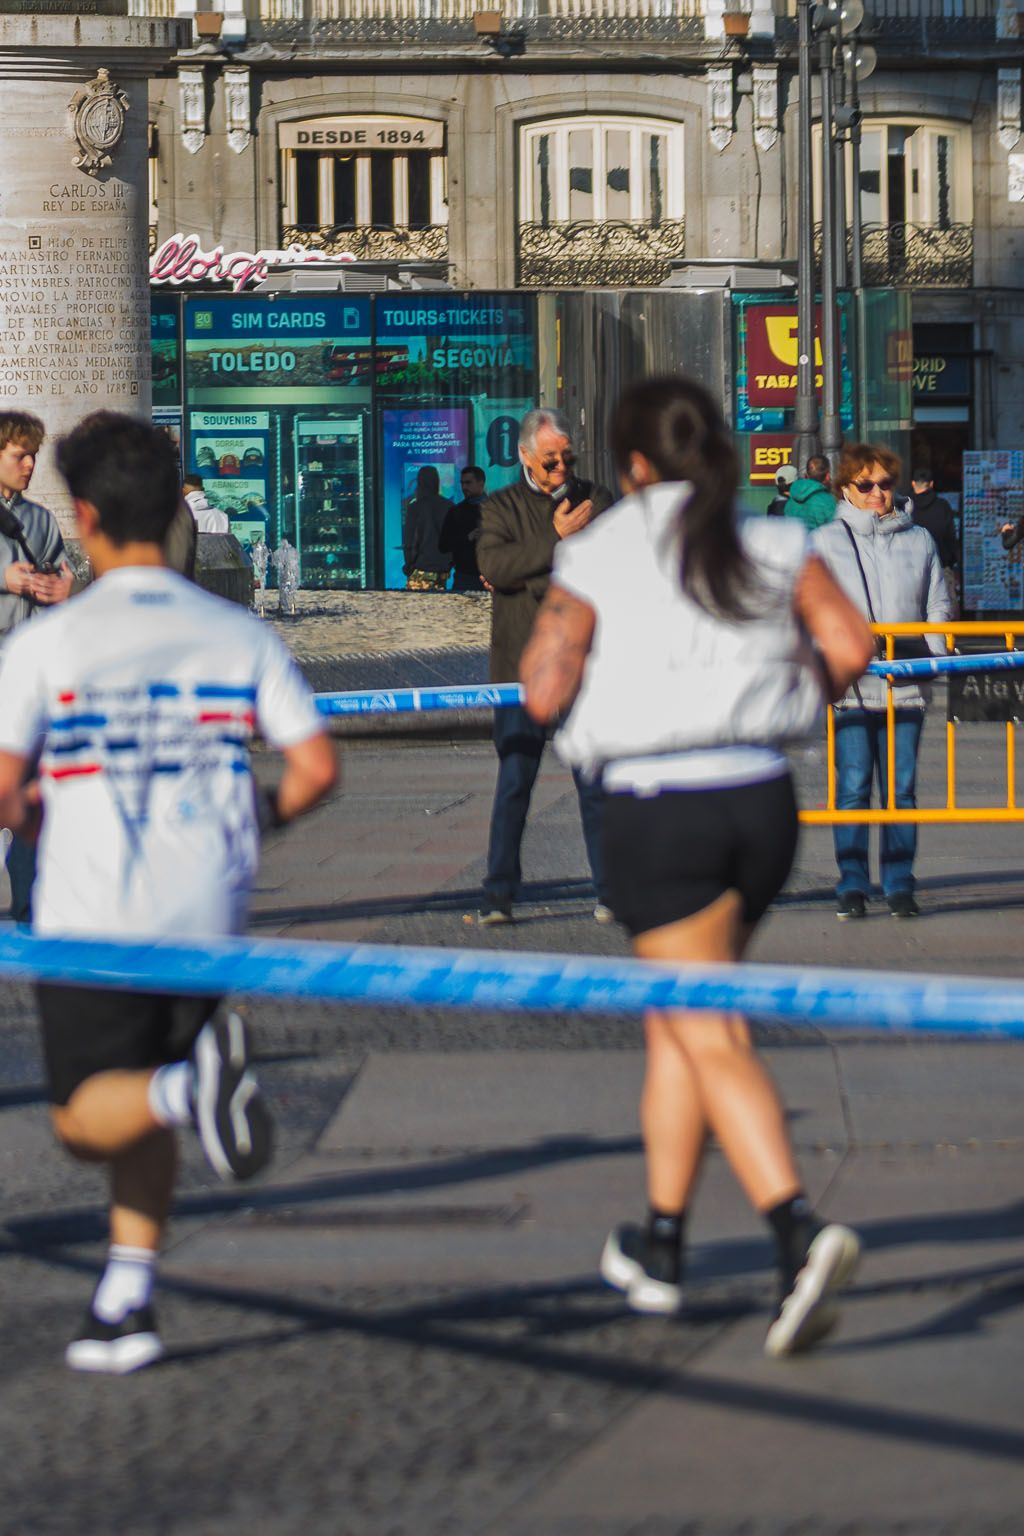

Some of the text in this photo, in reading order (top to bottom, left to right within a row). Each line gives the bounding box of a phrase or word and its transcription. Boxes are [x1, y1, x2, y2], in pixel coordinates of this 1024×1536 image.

[297, 130, 425, 144] DESDE 1894
[49, 183, 124, 198] CARLOS III
[42, 198, 128, 212] REY DE ESPAÑA
[48, 237, 75, 248] HIJO
[81, 237, 94, 248] DE
[99, 238, 128, 249] FELIPE
[76, 250, 130, 261] FERNANDO
[0, 264, 63, 275] ARTISTAS.
[69, 264, 135, 274] FORTALECIO
[78, 277, 131, 288] PATROCINO
[54, 291, 68, 301] LA
[76, 291, 124, 301] REFORMA
[5, 304, 57, 315] NAVALES
[66, 304, 115, 314] PROPICIO
[120, 304, 130, 314] LA
[8, 317, 25, 328] DE
[32, 317, 103, 328] MERCANCIAS
[110, 317, 116, 328] Y
[232, 312, 327, 329] SIM CARDS
[34, 330, 49, 341] DE
[57, 330, 114, 341] COMERCIO
[13, 344, 20, 355] Y
[1, 357, 78, 368] AMERICANAS
[85, 357, 132, 368] MEDIANTE
[208, 351, 296, 372] TOLEDO
[432, 348, 514, 368] SEGOVIA
[912, 358, 947, 373] DRID
[92, 370, 105, 381] DE
[28, 383, 43, 395] EN
[51, 383, 65, 395] EL
[74, 383, 98, 395] AÑO
[203, 415, 257, 425] SOUVENIRS
